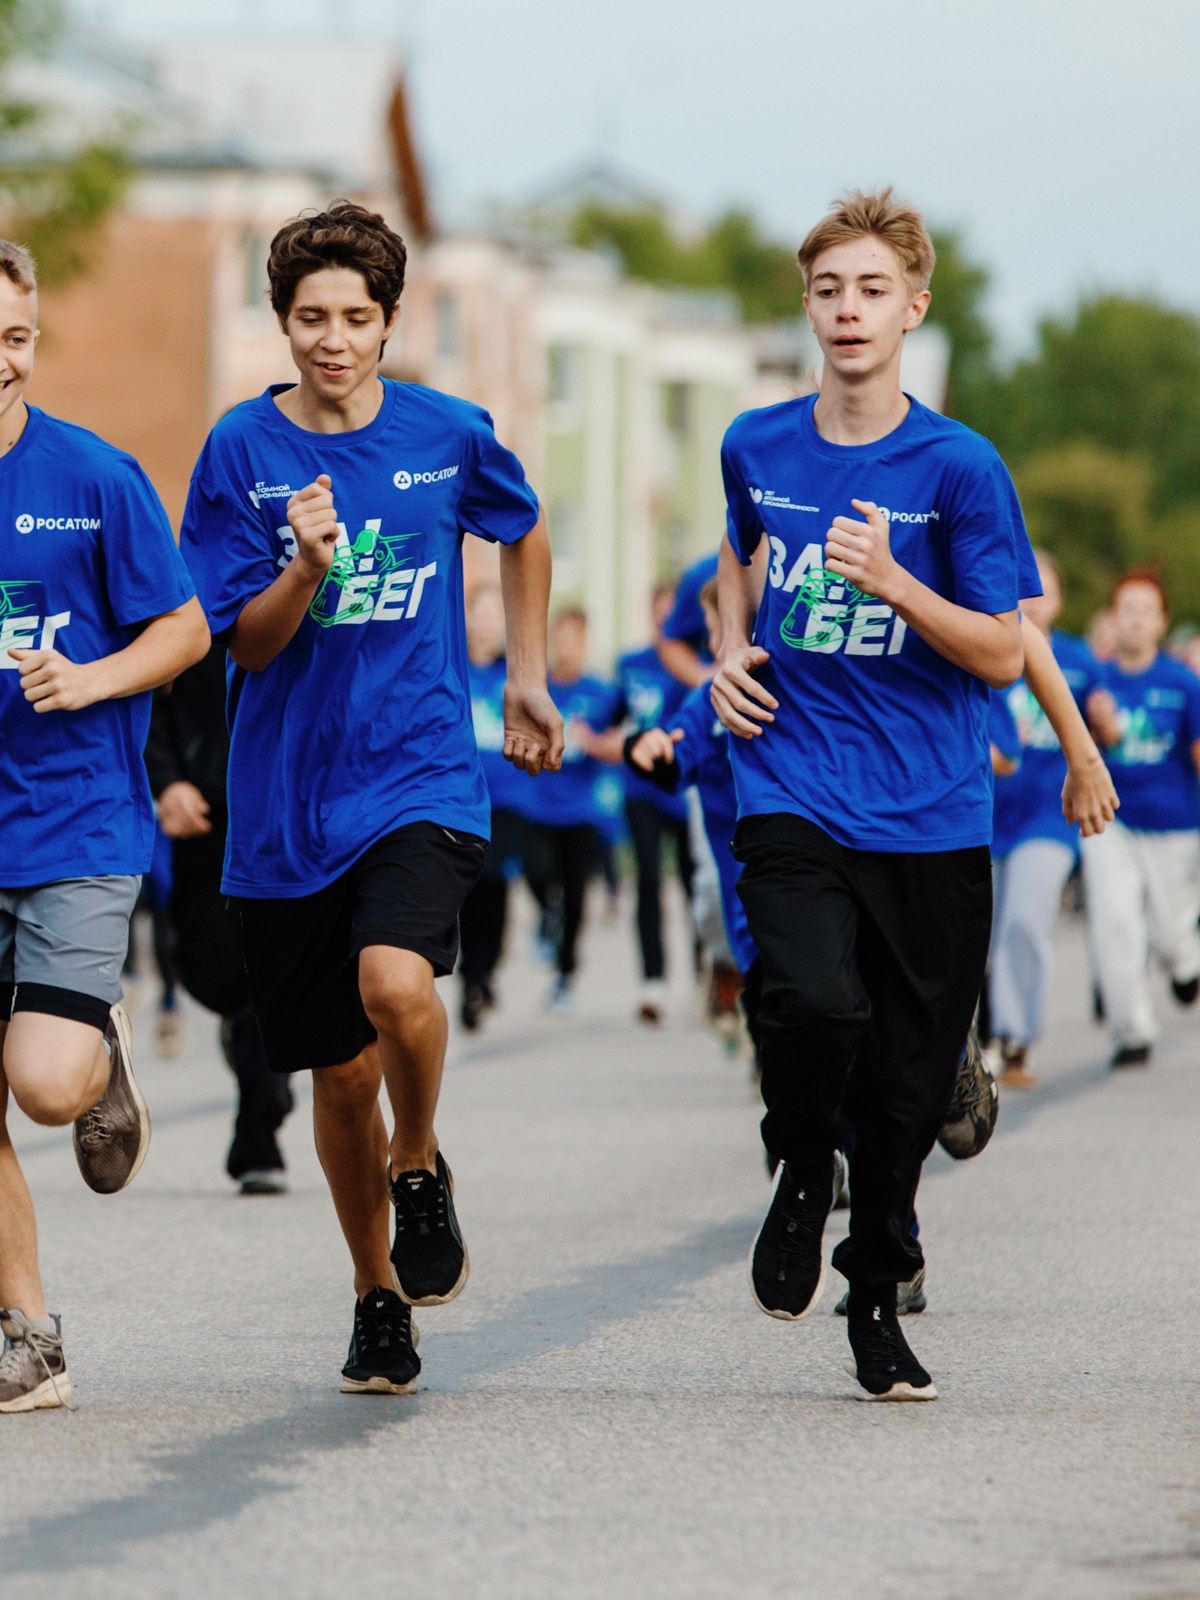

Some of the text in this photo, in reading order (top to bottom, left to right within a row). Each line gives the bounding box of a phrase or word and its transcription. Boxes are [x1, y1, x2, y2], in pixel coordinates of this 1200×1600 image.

[413, 465, 459, 485] РОСАТОМ
[256, 484, 290, 494] ТОМНОЙ
[36, 518, 101, 530] РОСАТОМ
[891, 510, 940, 524] РОСАТМ
[333, 561, 438, 626] БЕГ
